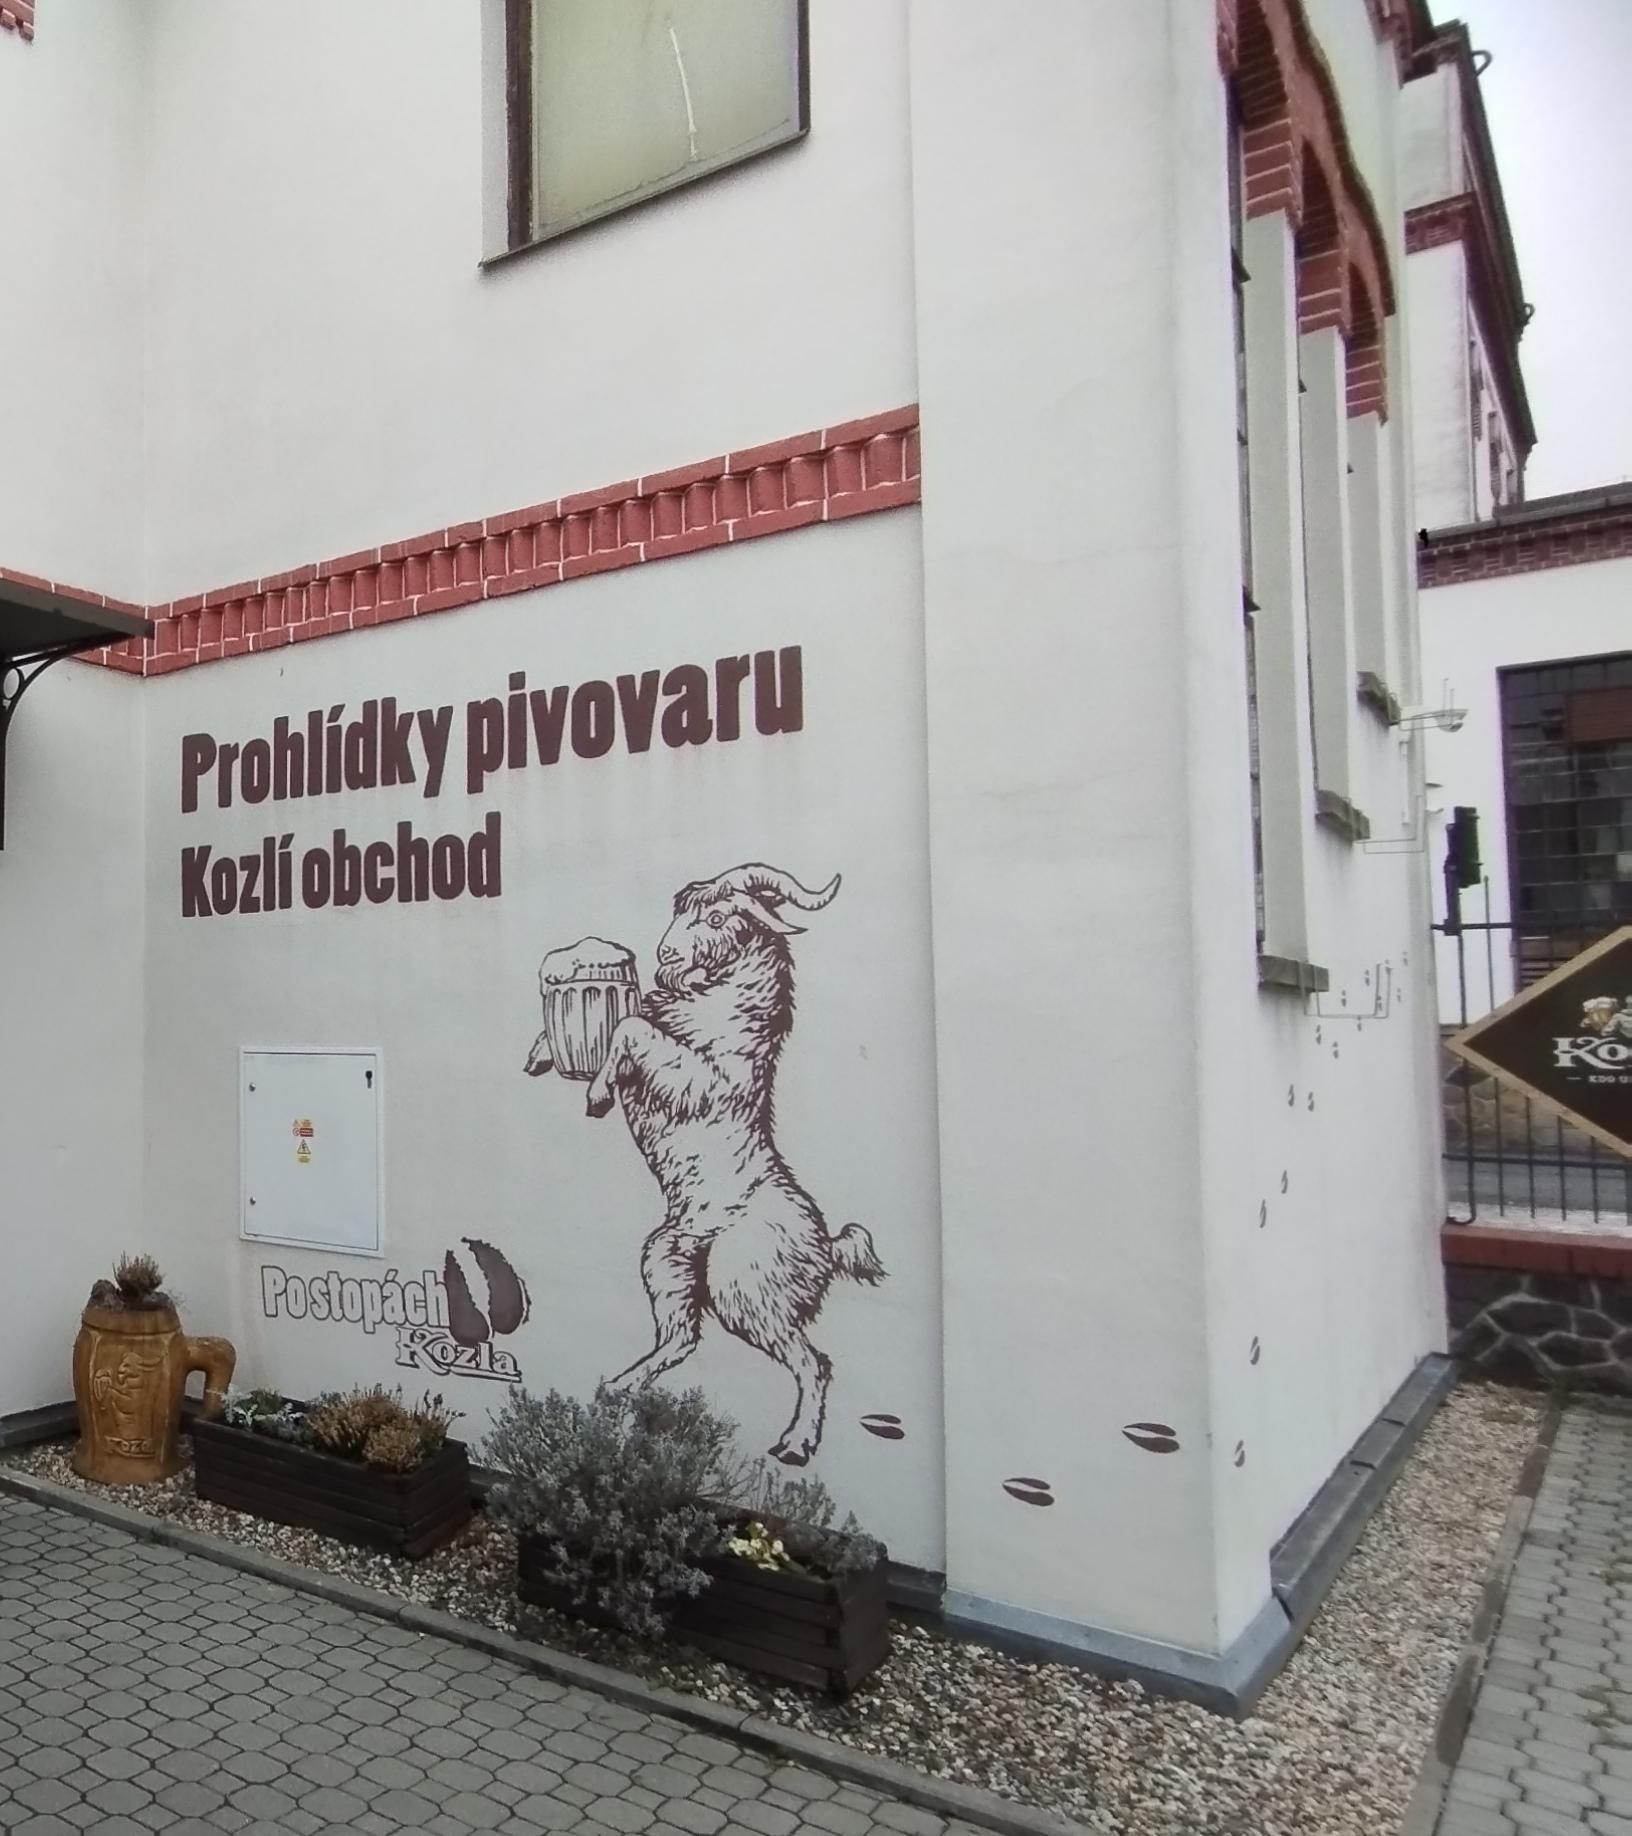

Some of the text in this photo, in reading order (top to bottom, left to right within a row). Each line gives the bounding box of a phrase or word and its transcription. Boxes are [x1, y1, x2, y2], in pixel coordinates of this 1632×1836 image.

[181, 645, 803, 813] Prohlídky pivovaru
[181, 811, 502, 918] Kozlí obchod
[1552, 1036, 1632, 1069] Ko
[261, 1265, 450, 1333] Postopách
[395, 1326, 521, 1383] Kozla
